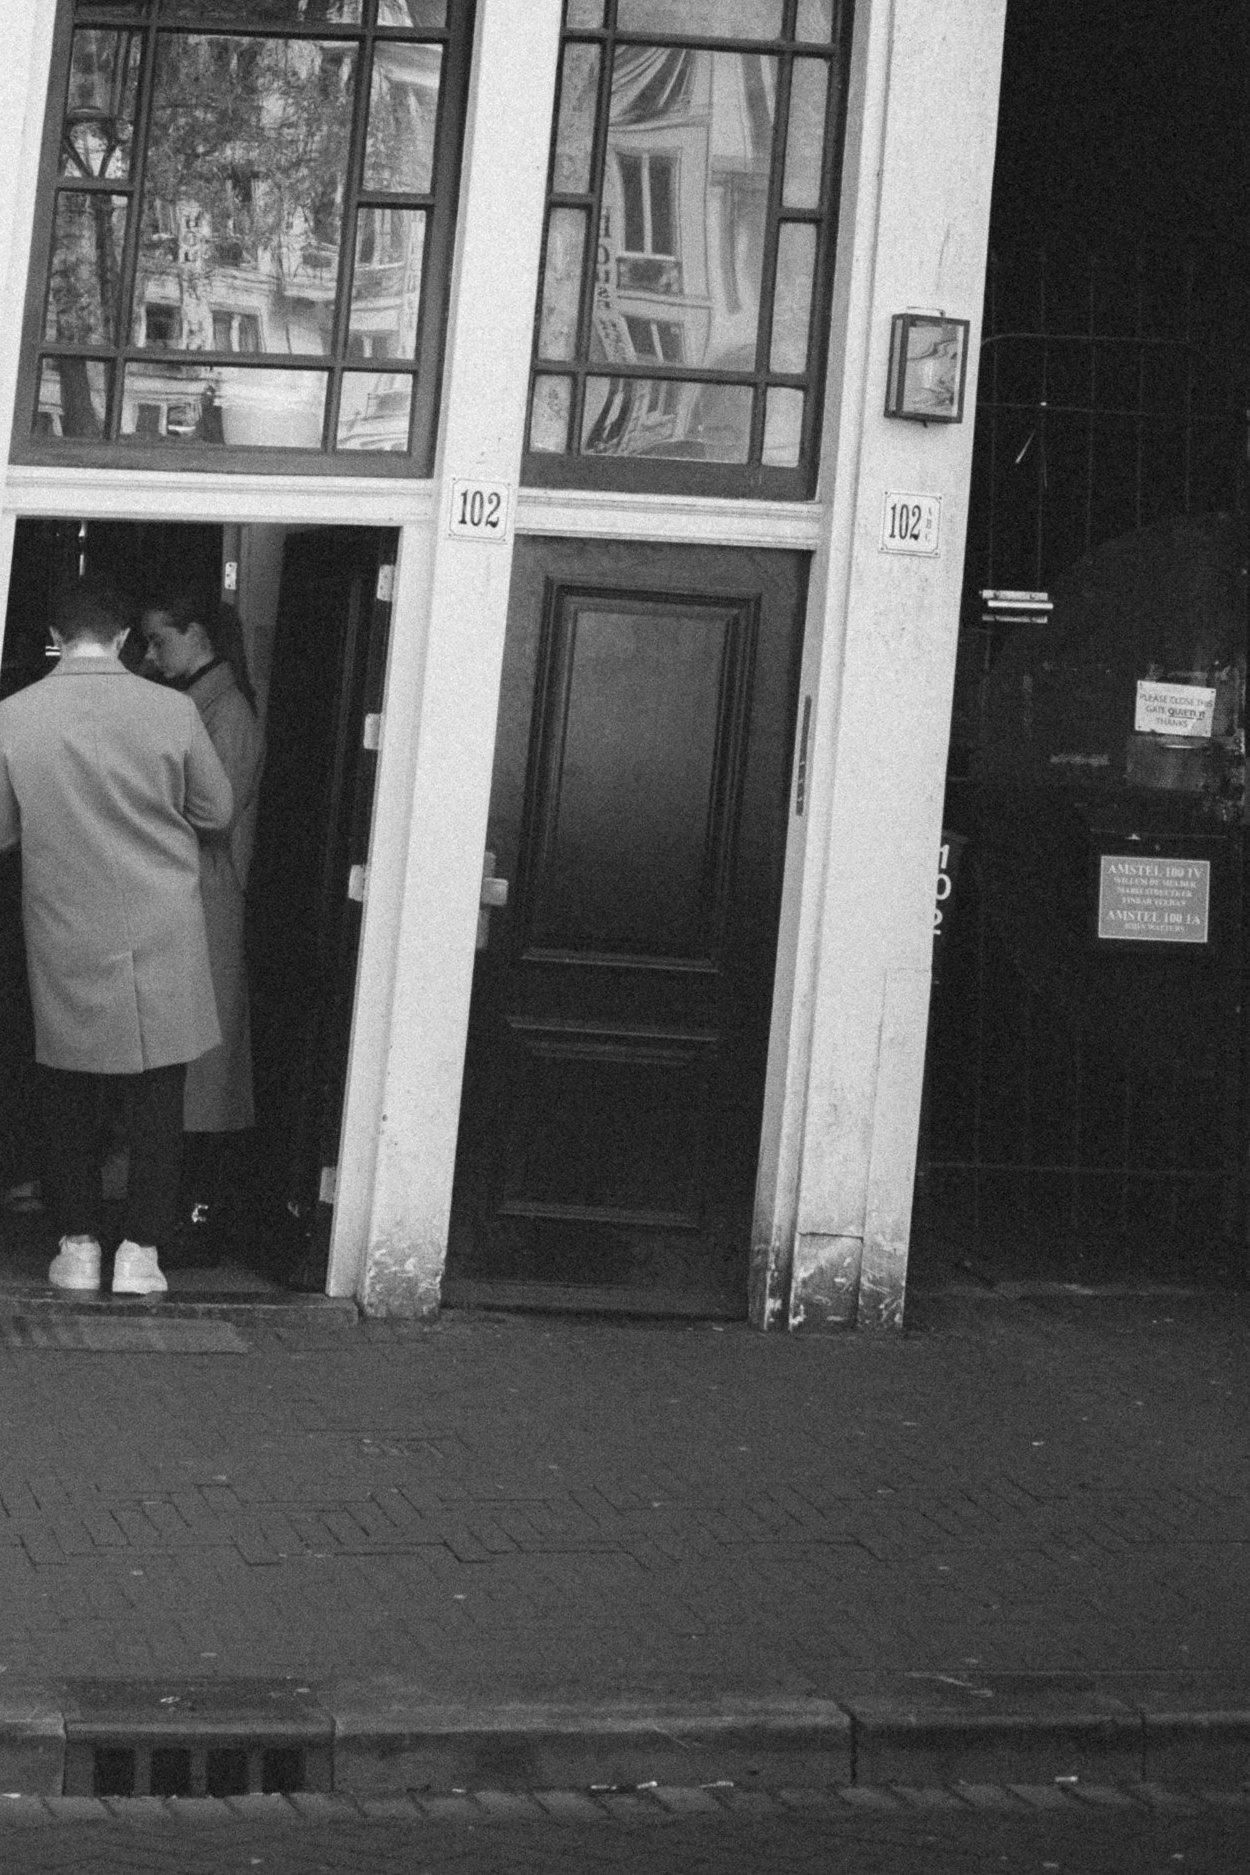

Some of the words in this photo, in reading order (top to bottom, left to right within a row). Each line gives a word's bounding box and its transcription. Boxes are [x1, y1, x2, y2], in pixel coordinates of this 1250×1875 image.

[458, 489, 501, 528] 102
[889, 503, 922, 541] 102
[1109, 863, 1162, 877] AMSTEL
[1165, 866, 1185, 878] 100
[1107, 909, 1161, 923] AMSTEL
[1164, 911, 1183, 924] 100
